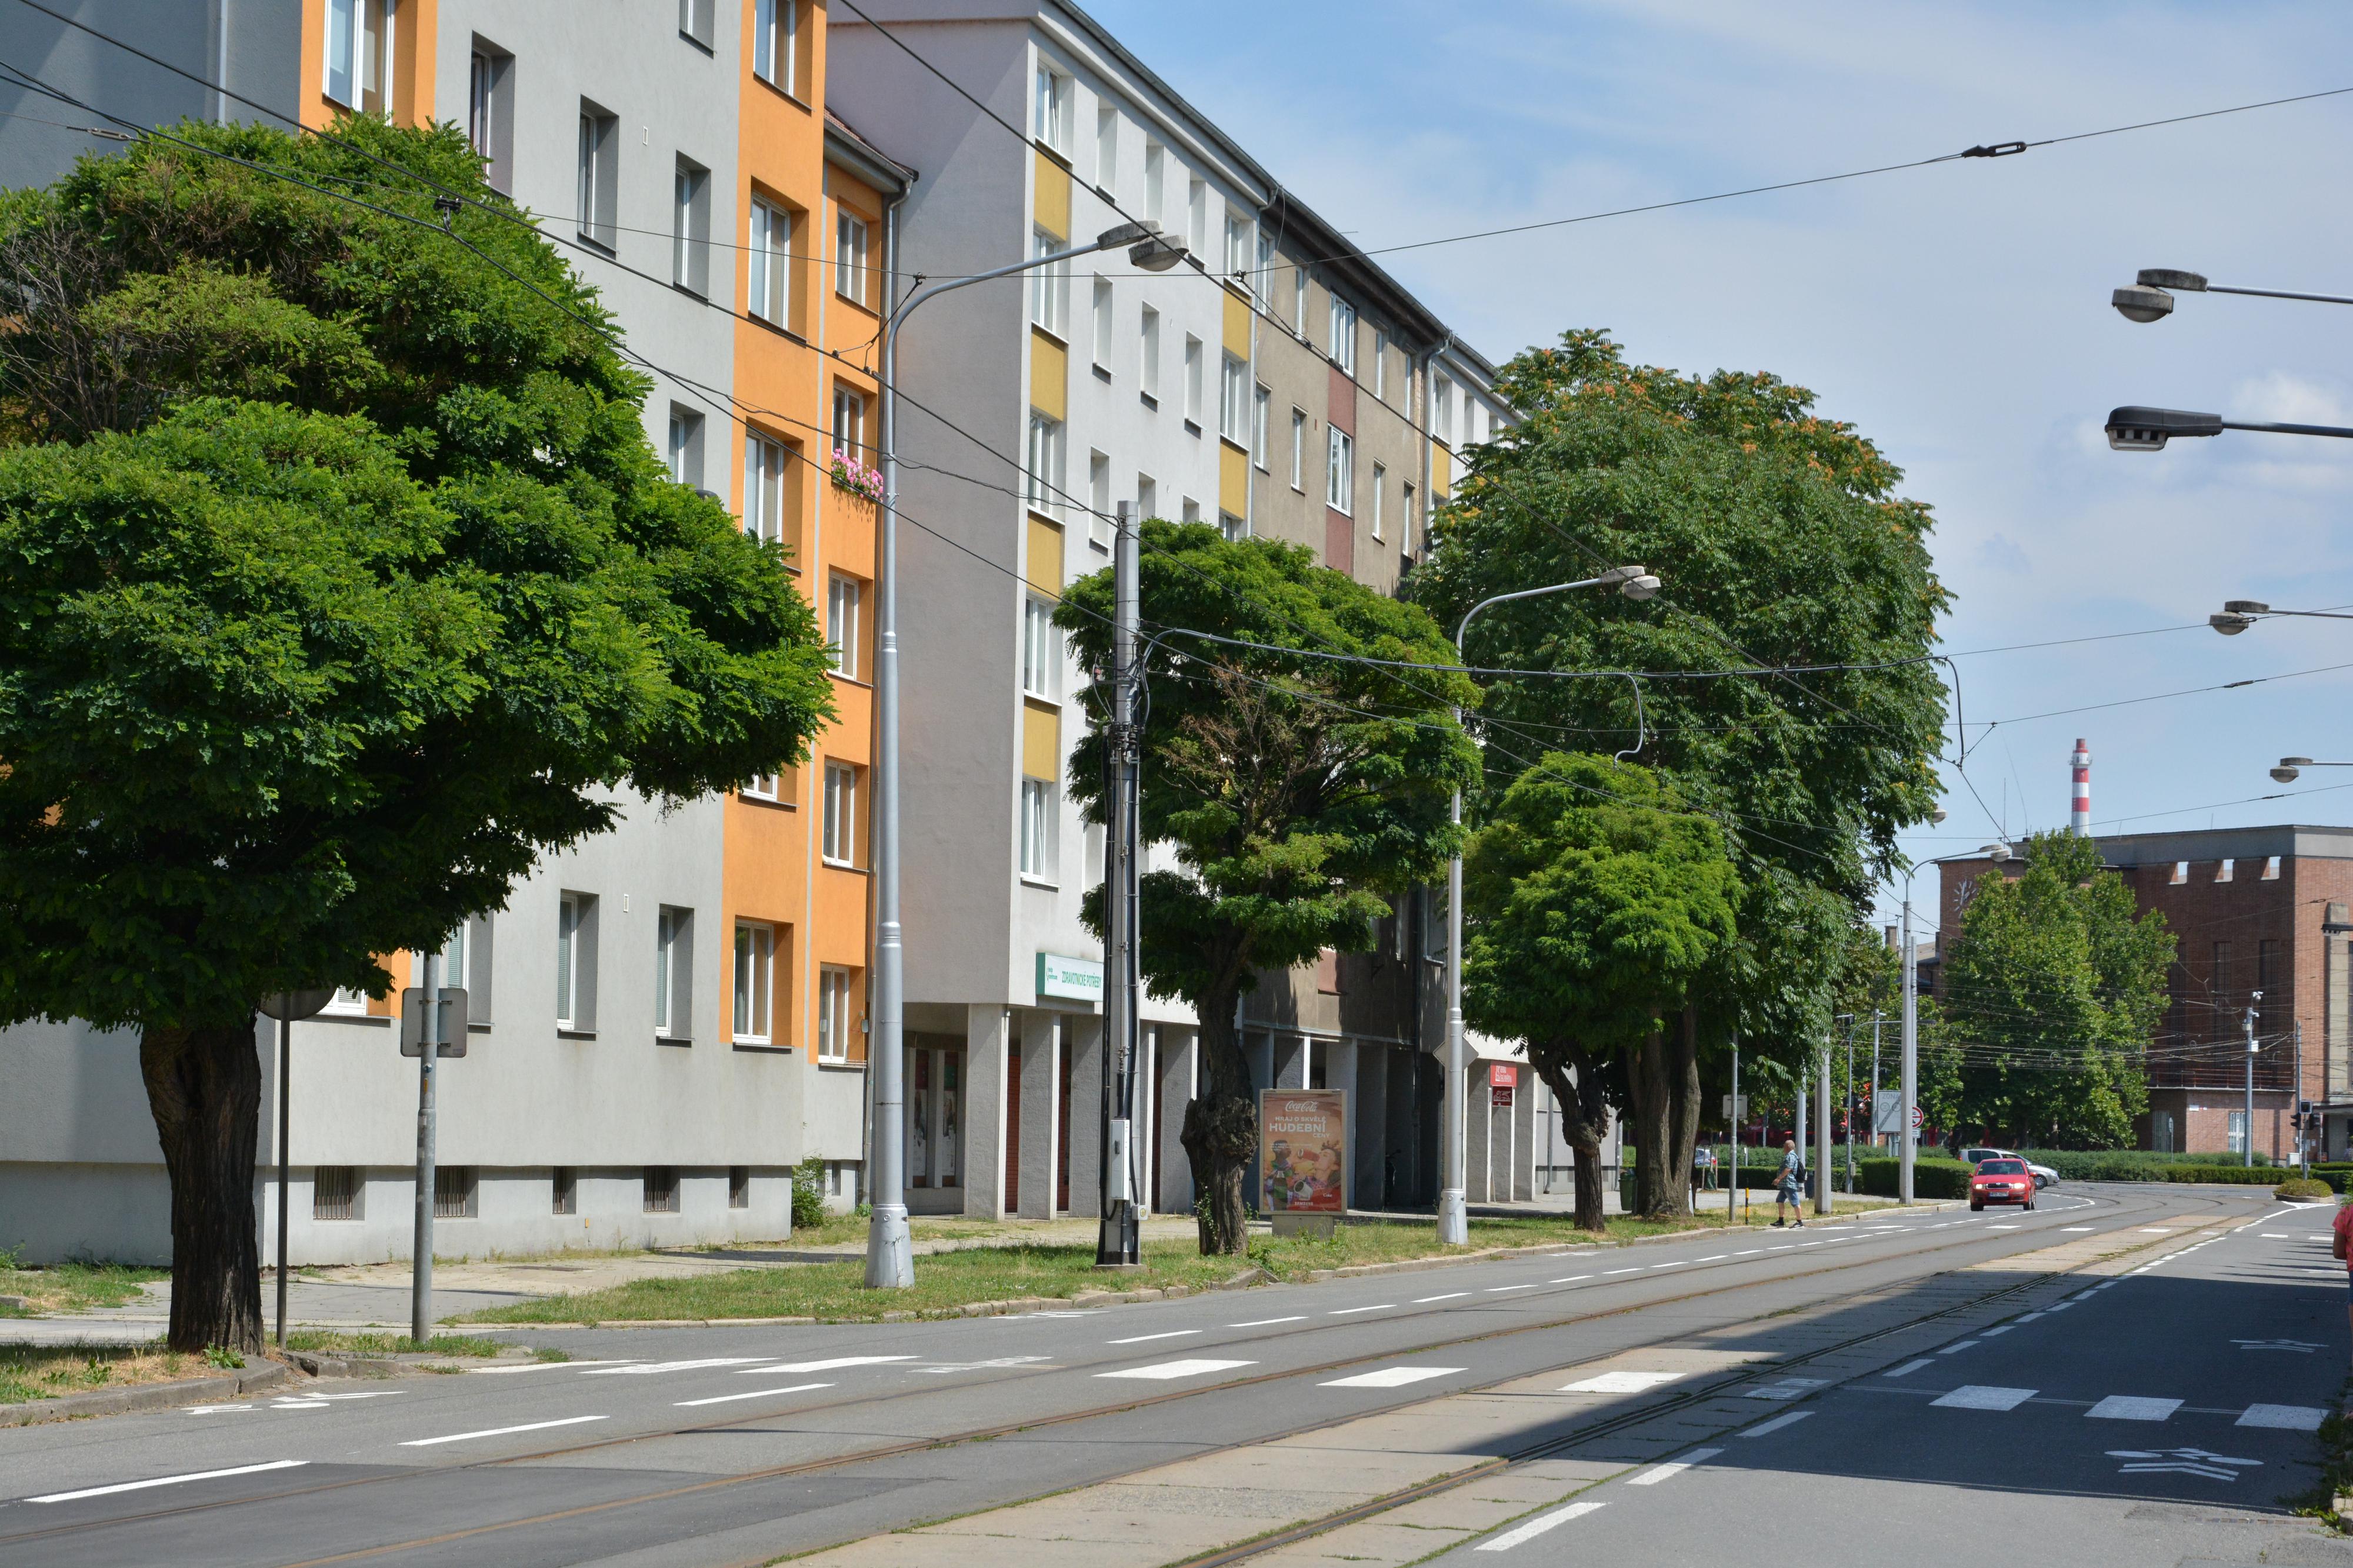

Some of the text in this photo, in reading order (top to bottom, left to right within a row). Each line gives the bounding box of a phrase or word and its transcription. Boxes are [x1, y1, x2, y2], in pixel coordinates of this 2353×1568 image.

[1062, 970, 1102, 988] ZDRAVOTNICKÉ POTŘEBY
[1285, 1100, 1318, 1112] Coca-Cola
[1269, 1122, 1325, 1132] HUDEBNÍ
